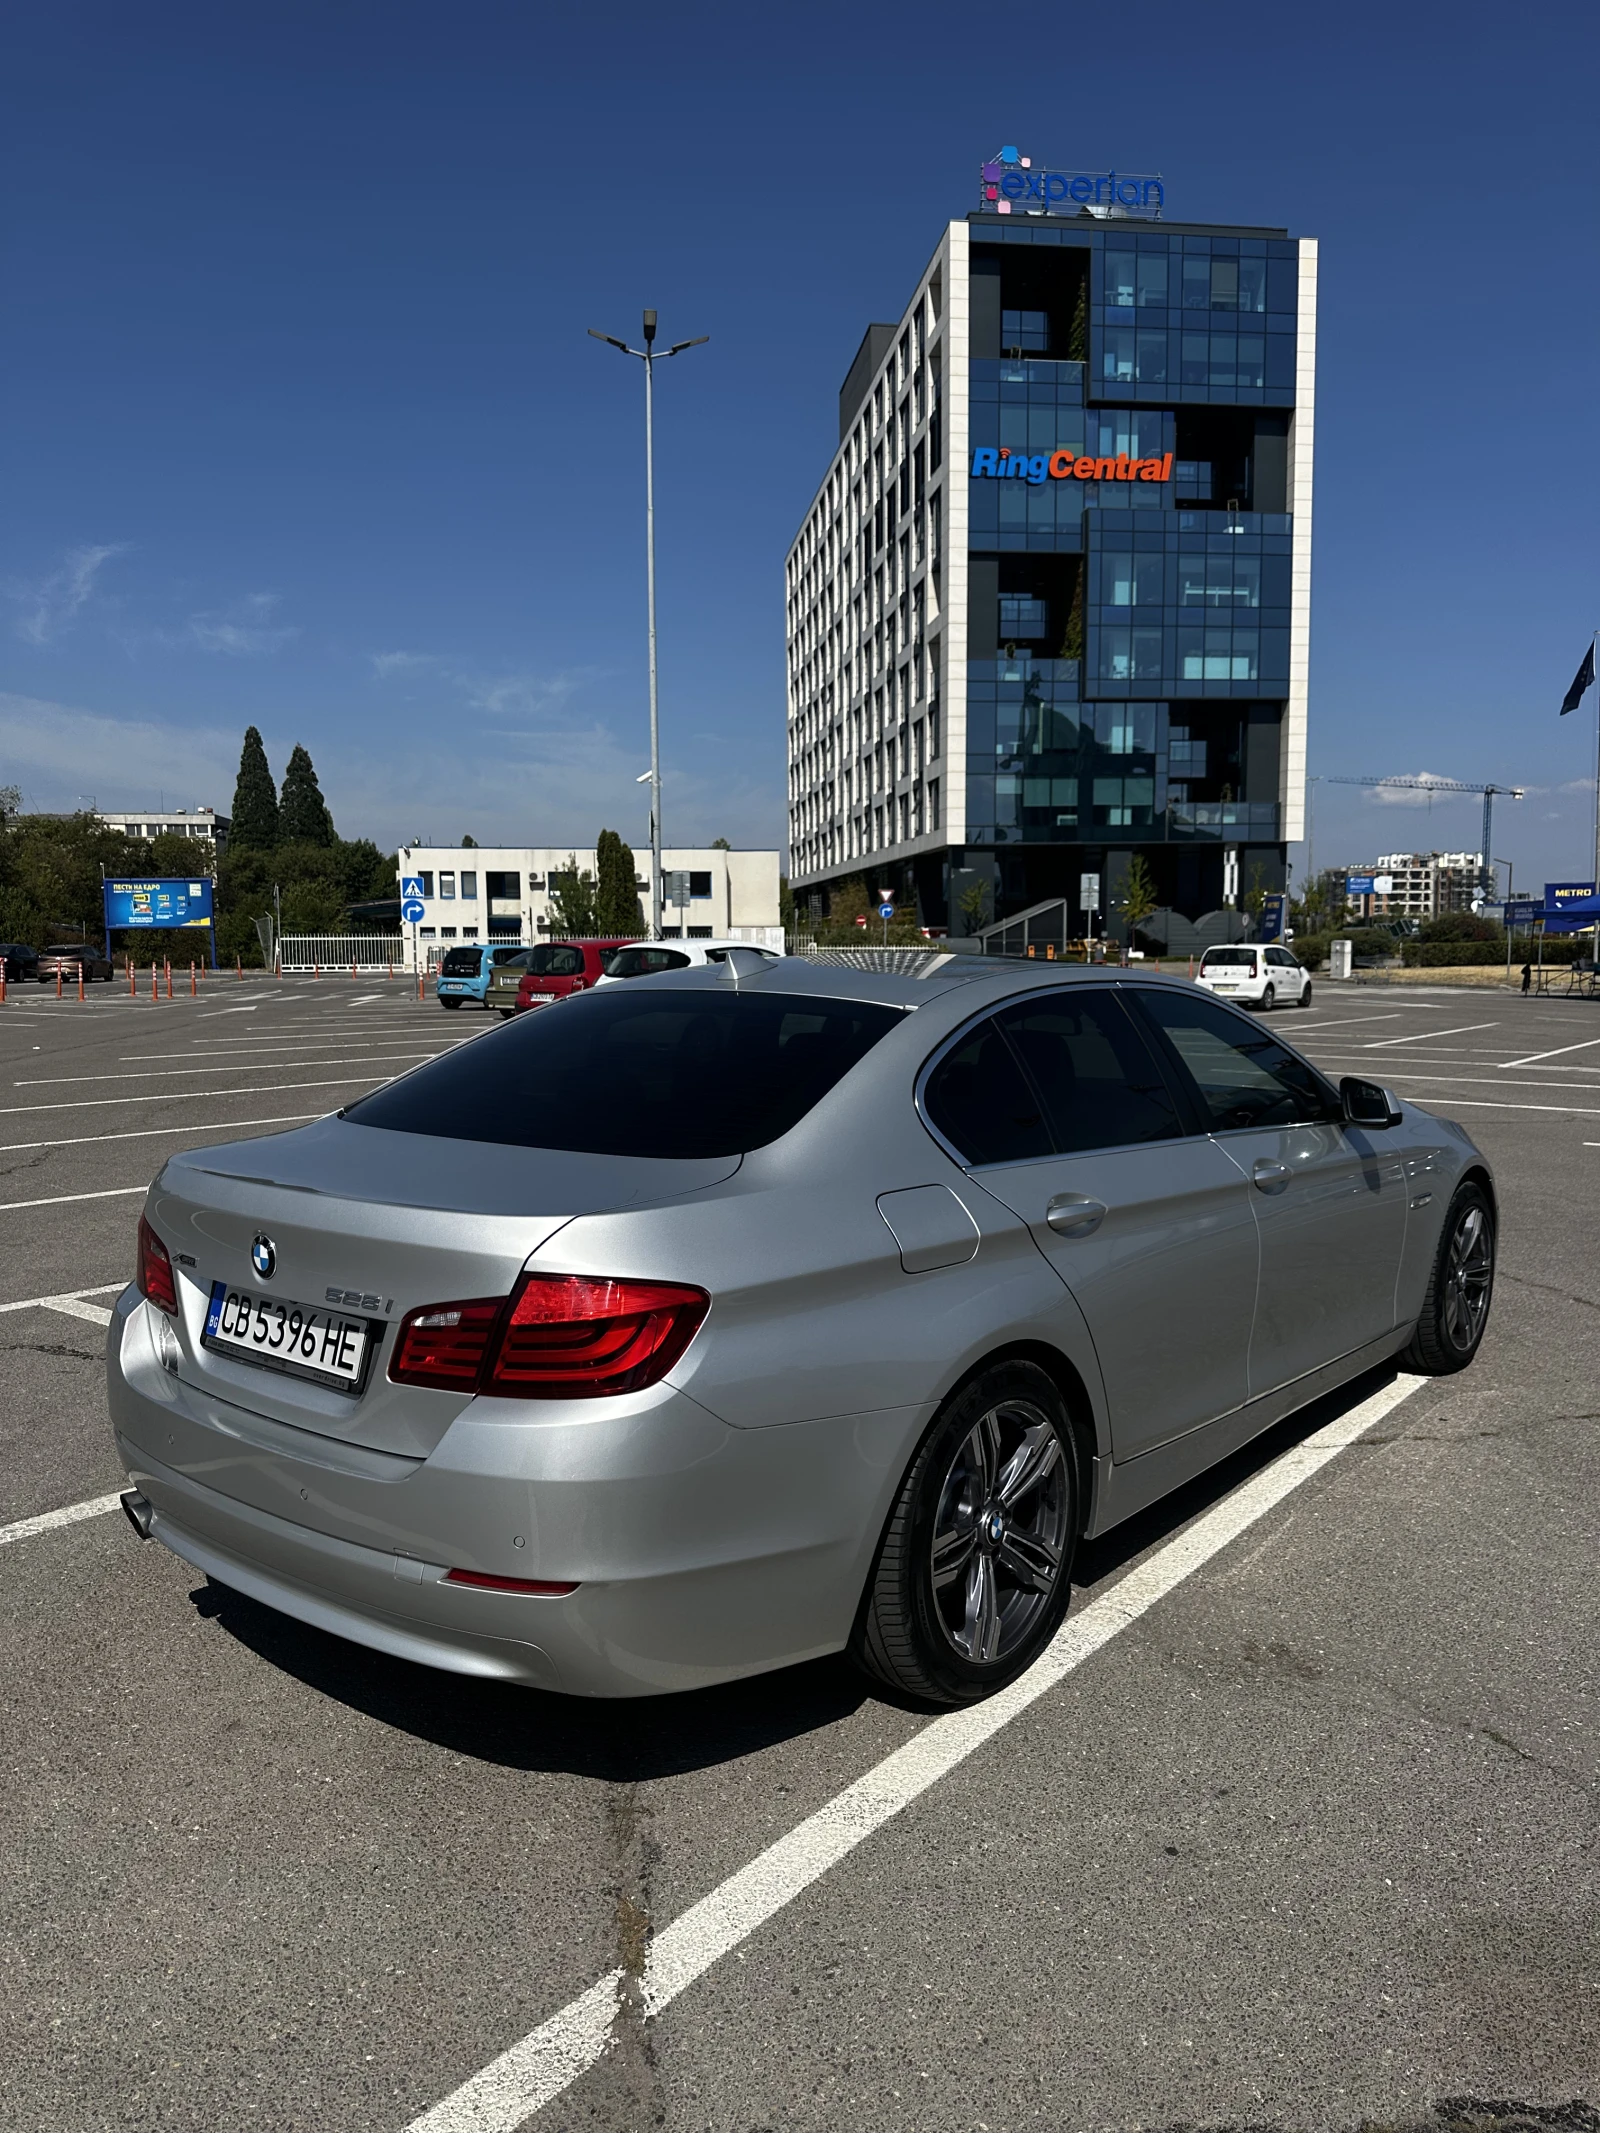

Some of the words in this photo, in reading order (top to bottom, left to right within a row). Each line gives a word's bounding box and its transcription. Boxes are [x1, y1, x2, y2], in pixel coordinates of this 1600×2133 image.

[1001, 170, 1164, 209] experian
[971, 447, 1173, 484] RingCentral
[1555, 888, 1592, 897] METRO
[208, 1315, 219, 1329] BG
[221, 1292, 252, 1337] CB
[252, 1300, 317, 1358] 5396
[319, 1317, 360, 1371] HE
[313, 1372, 345, 1388] overdrive.bg
